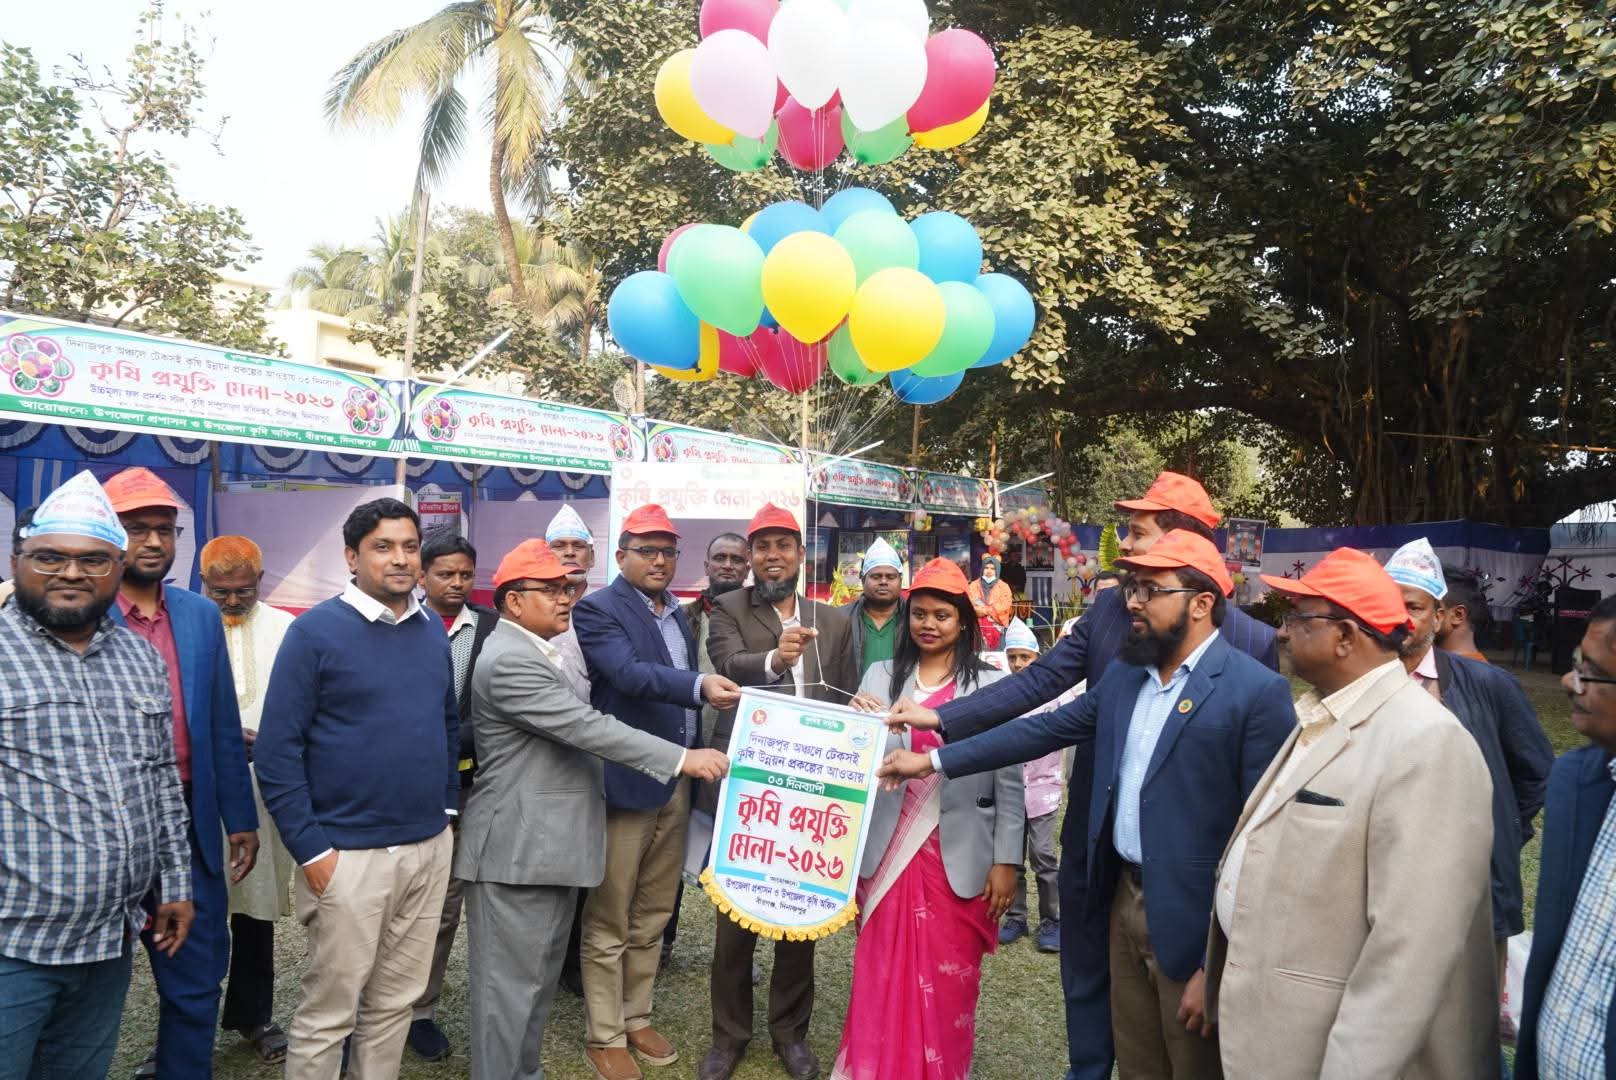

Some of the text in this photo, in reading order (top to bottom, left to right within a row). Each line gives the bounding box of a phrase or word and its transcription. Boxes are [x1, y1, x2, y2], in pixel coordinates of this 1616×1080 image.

[66, 336, 112, 354] দিনাজপুর
[186, 356, 201, 368] কৃষি
[88, 360, 334, 408] কৃষি প্রযুক্তি মেলা-২০২৬
[93, 407, 144, 422] উপজেলা
[147, 414, 187, 428] প্রশাসন
[191, 420, 201, 428] ও
[203, 420, 246, 434] উপজেলা
[249, 426, 268, 438] কৃষি
[340, 434, 377, 449] দিনাজপুর
[468, 412, 495, 428] কৃষি
[501, 418, 536, 434] প্রযুক্তি
[616, 481, 651, 512] কৃষি
[658, 481, 709, 511] প্রযুক্তি
[749, 731, 861, 766] দিনাজপুর অঞ্চলে টেকসই
[737, 747, 865, 784] কৃষি উন্নয়ন প্রকল্পের আওতায়
[767, 775, 825, 795] ০৩ দিনব্যাপী
[738, 790, 851, 845] কৃষি প্রযুক্তি
[728, 832, 844, 880] মেলা-২০২৬
[726, 878, 751, 893] উপজেলা
[752, 884, 773, 894] প্রশাসন
[774, 889, 779, 897] ও
[781, 888, 805, 901] উপজেলা
[807, 895, 818, 908] কৃষি
[780, 902, 807, 915] দিনাজপুর
